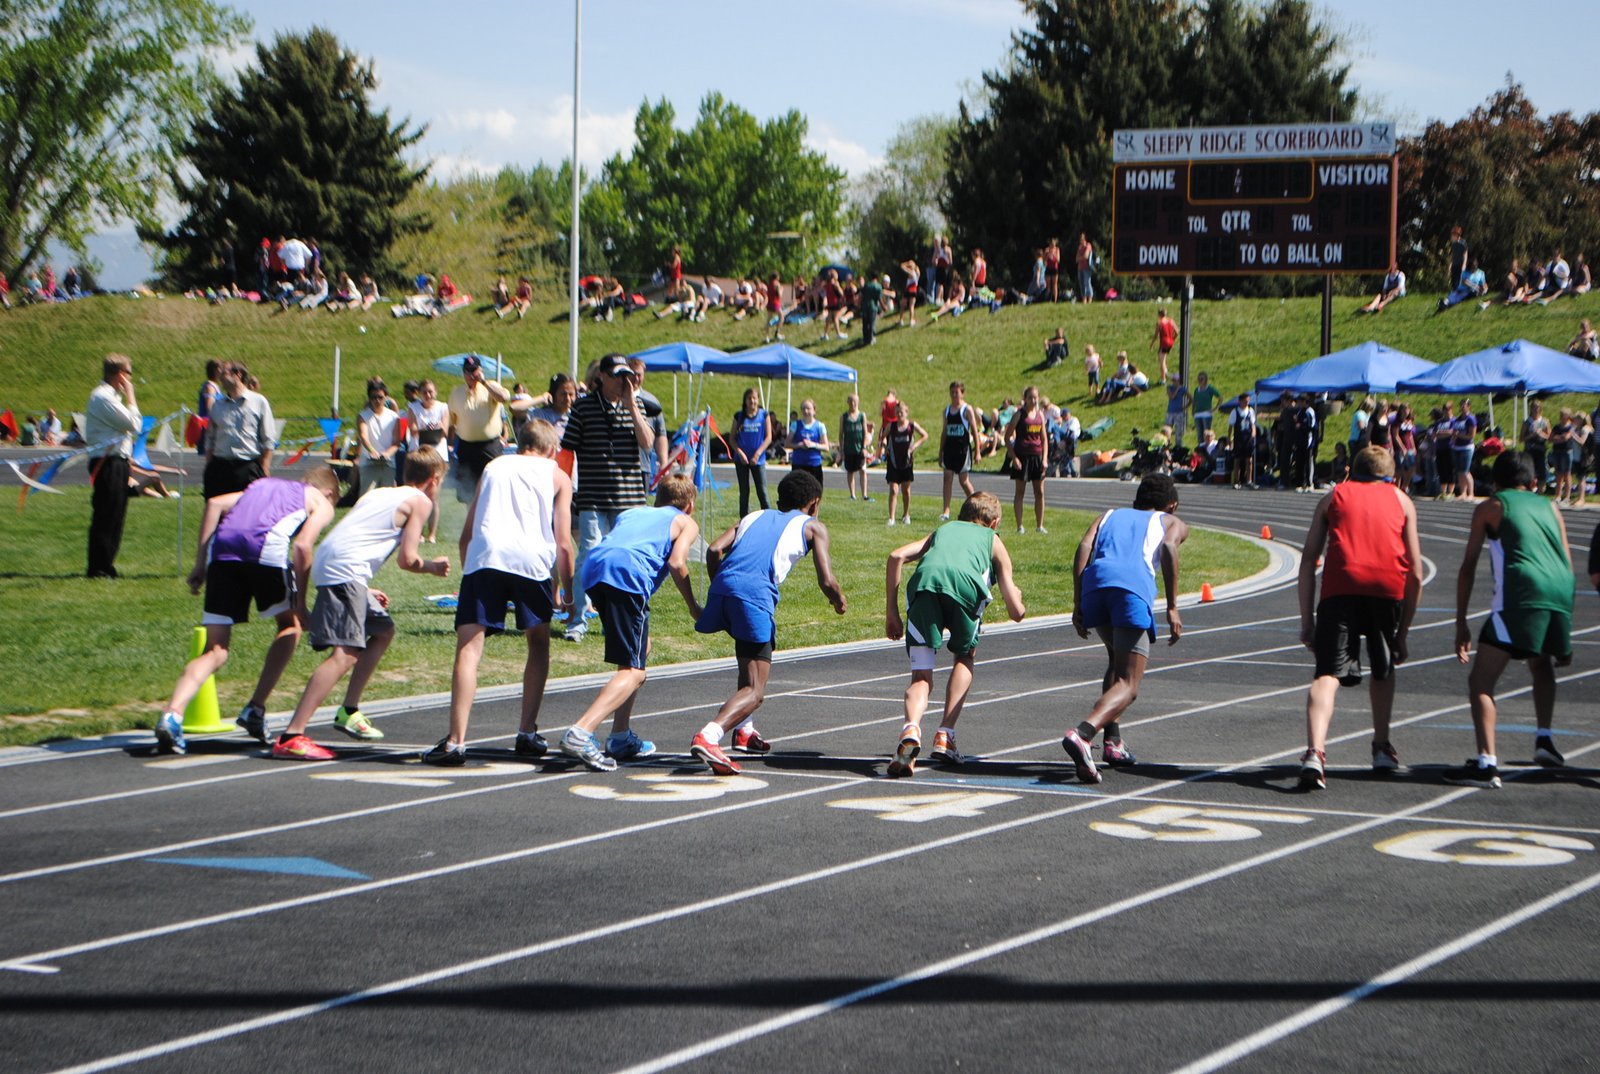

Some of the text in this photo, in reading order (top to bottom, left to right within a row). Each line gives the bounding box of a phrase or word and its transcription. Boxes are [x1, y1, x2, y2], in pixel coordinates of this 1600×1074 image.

[1144, 134, 1193, 155] SLEEPY
[1200, 131, 1247, 152] RIDGE
[1255, 127, 1363, 151] SCOREBOARD
[1125, 170, 1175, 190] HOME
[1319, 164, 1389, 186] VISITOR
[1188, 216, 1208, 233] TOL
[1221, 211, 1251, 231] QTR
[1292, 214, 1313, 232] TOL
[1139, 245, 1179, 265] DOWN
[1240, 244, 1280, 264] TO GO
[1288, 243, 1343, 263] BALL ON
[569, 773, 769, 802] 3
[826, 793, 1022, 823] 4
[1089, 805, 1313, 842] 5
[1373, 829, 1595, 867] 6
